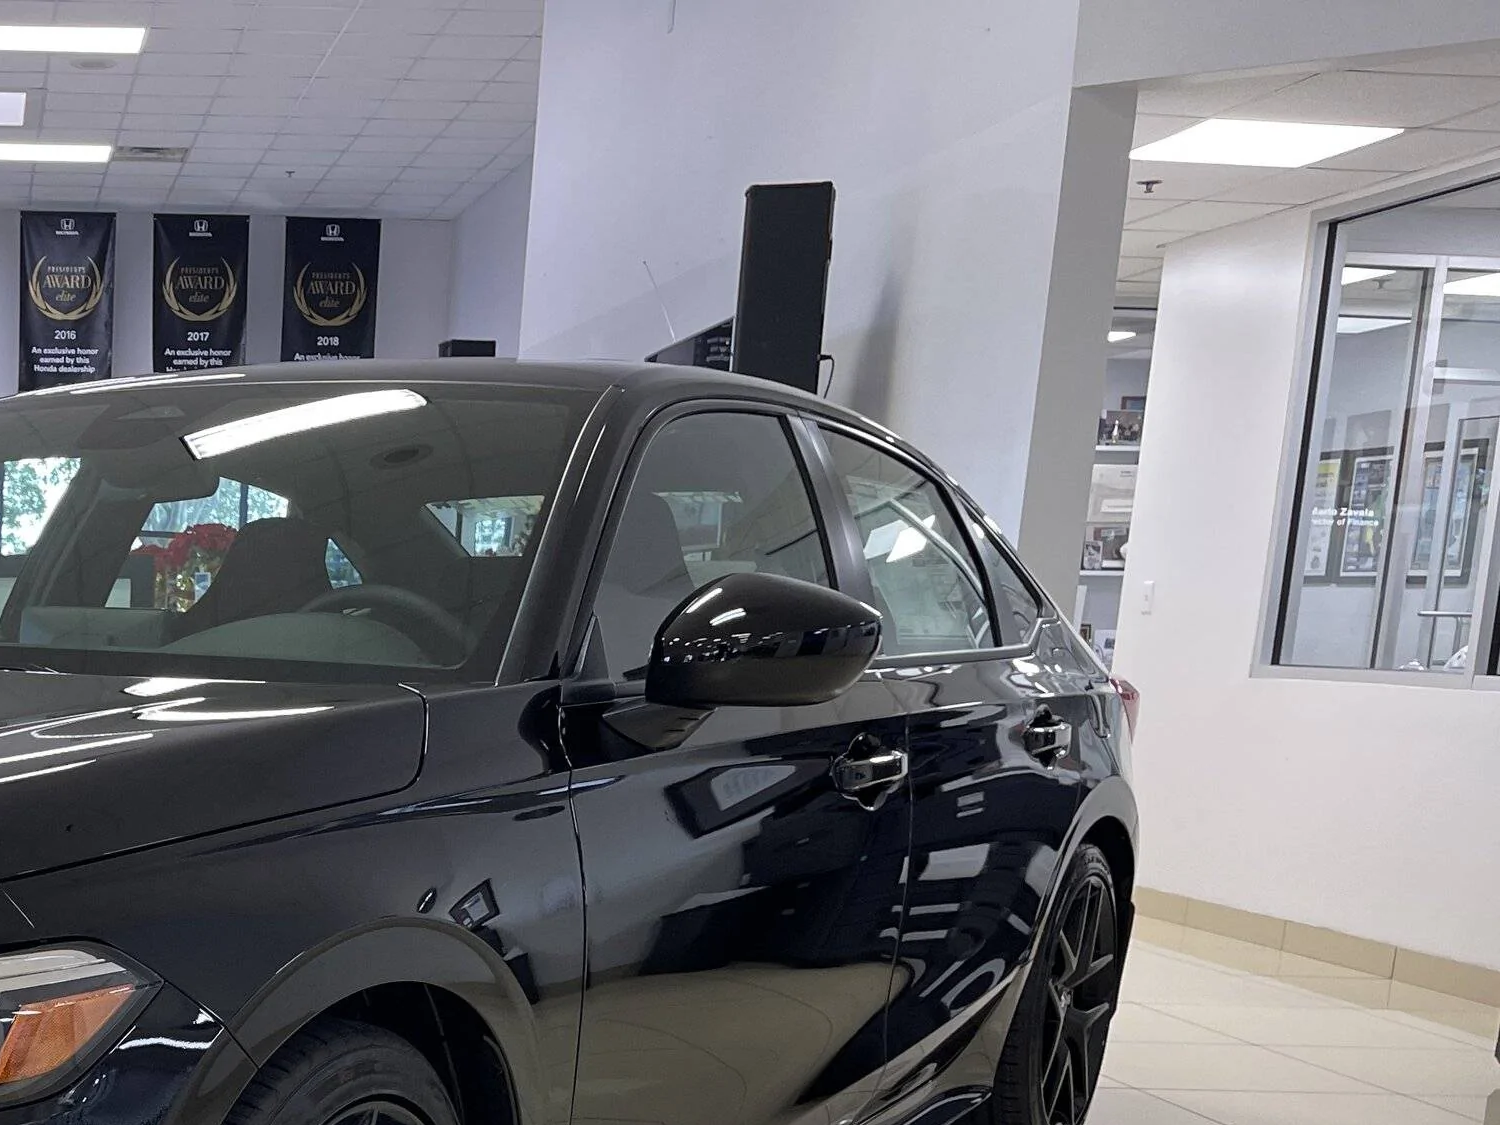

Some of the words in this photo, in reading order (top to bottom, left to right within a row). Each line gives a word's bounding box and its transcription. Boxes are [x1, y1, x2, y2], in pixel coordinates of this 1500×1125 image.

[43, 274, 91, 289] AWARD
[176, 275, 224, 290] AWARD
[308, 281, 355, 295] AWARD
[55, 291, 76, 302] elite
[189, 292, 210, 303] elite
[319, 296, 340, 307] elite
[54, 330, 76, 340] 2016
[187, 332, 210, 341] 2017
[317, 336, 339, 346] 2018
[43, 347, 75, 355] exclusive
[77, 347, 99, 355] honor
[164, 348, 175, 356] An
[176, 348, 208, 356] exclusive
[209, 349, 231, 357] honor
[66, 357, 74, 365] by
[294, 353, 304, 361] An
[173, 358, 198, 366] earned
[200, 358, 208, 367] by
[209, 358, 223, 366] this
[34, 364, 57, 373] Honda
[59, 365, 96, 374] dealership
